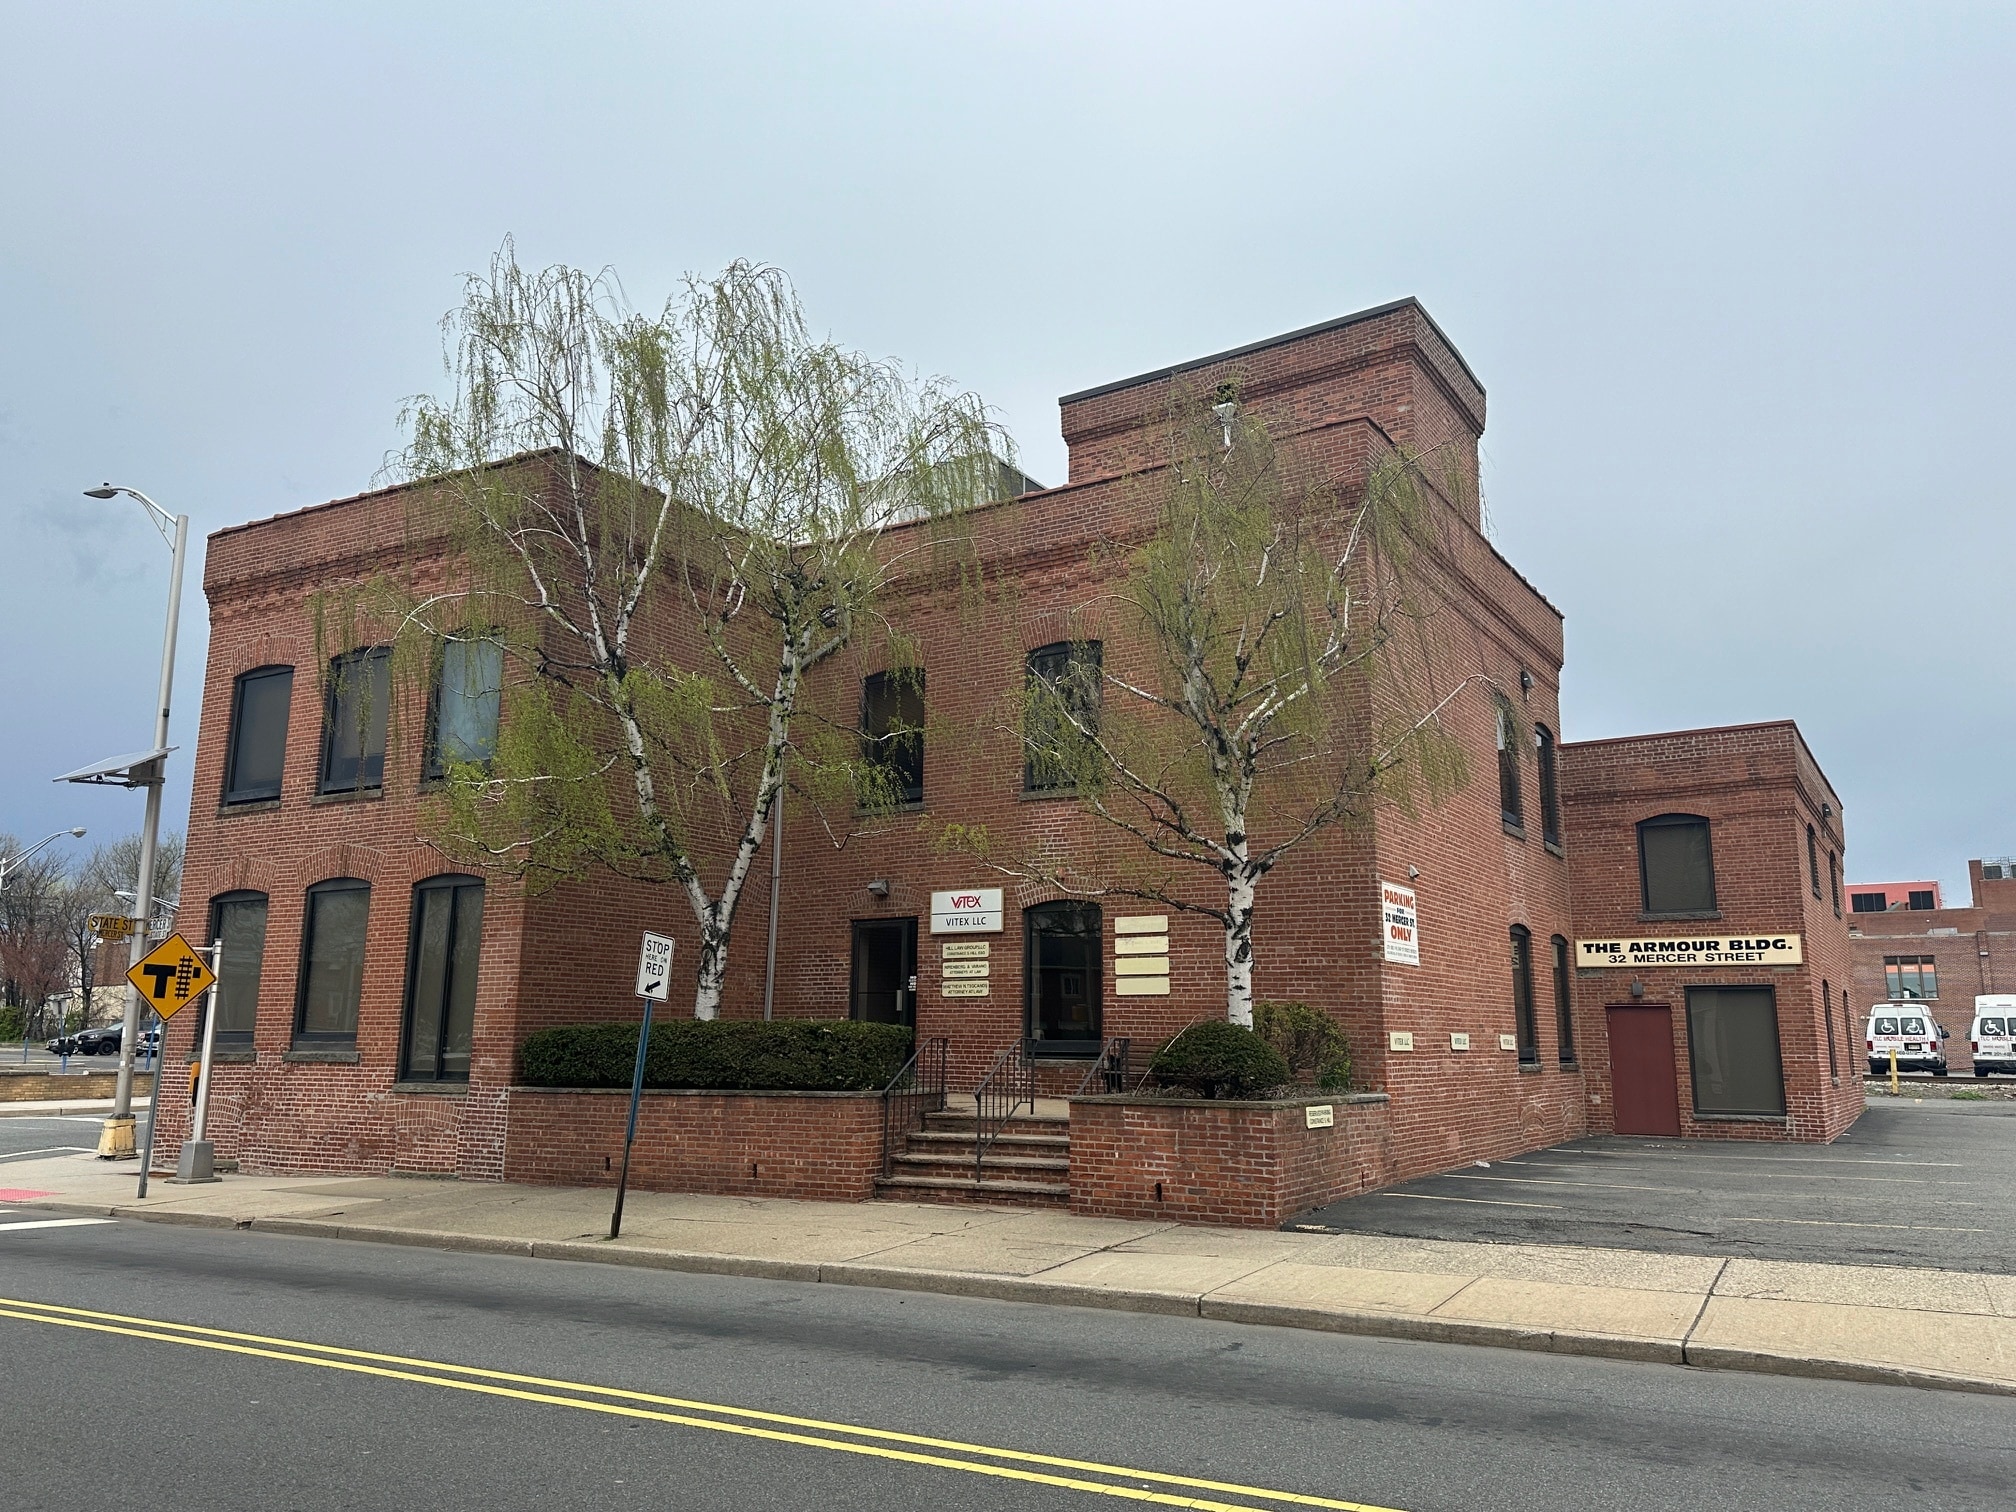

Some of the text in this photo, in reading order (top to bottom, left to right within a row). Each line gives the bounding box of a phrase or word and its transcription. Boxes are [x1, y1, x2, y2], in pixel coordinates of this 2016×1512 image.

[1384, 889, 1414, 909] PARKING
[91, 916, 133, 931] STATE ST
[946, 916, 987, 926] VITEX LLC
[1385, 912, 1391, 922] 32
[1392, 914, 1409, 926] MERCER
[1391, 925, 1412, 942] ONLY
[646, 939, 670, 955] STOP
[1583, 938, 1793, 954] THE ARMOUR BLDG.
[646, 953, 657, 962] HERE
[1608, 951, 1766, 964] 32 MERCER STREET
[645, 962, 664, 976] RED
